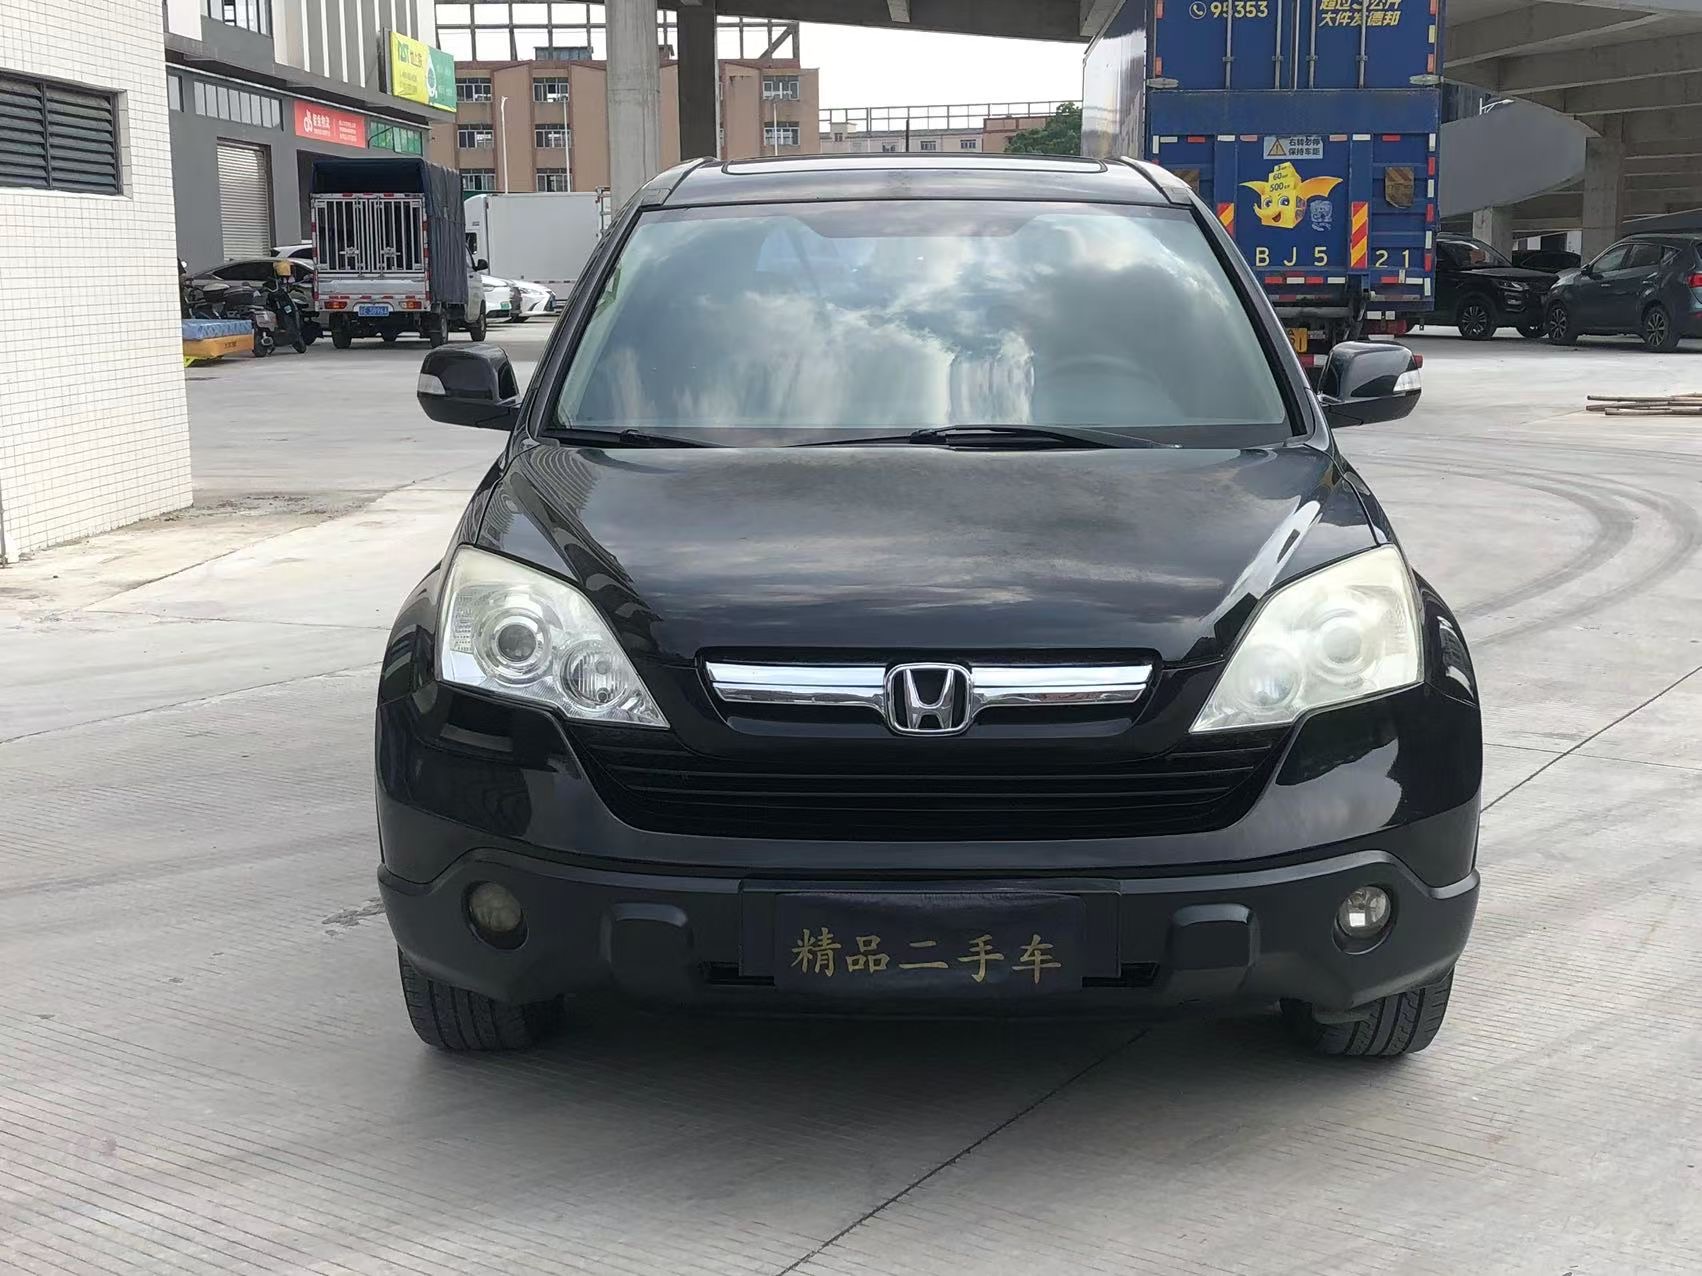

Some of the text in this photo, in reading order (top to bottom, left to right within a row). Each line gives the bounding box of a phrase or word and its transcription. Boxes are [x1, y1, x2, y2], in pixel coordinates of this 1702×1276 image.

[1210, 1, 1268, 18] 95353
[791, 927, 1062, 984] 精品二手车
